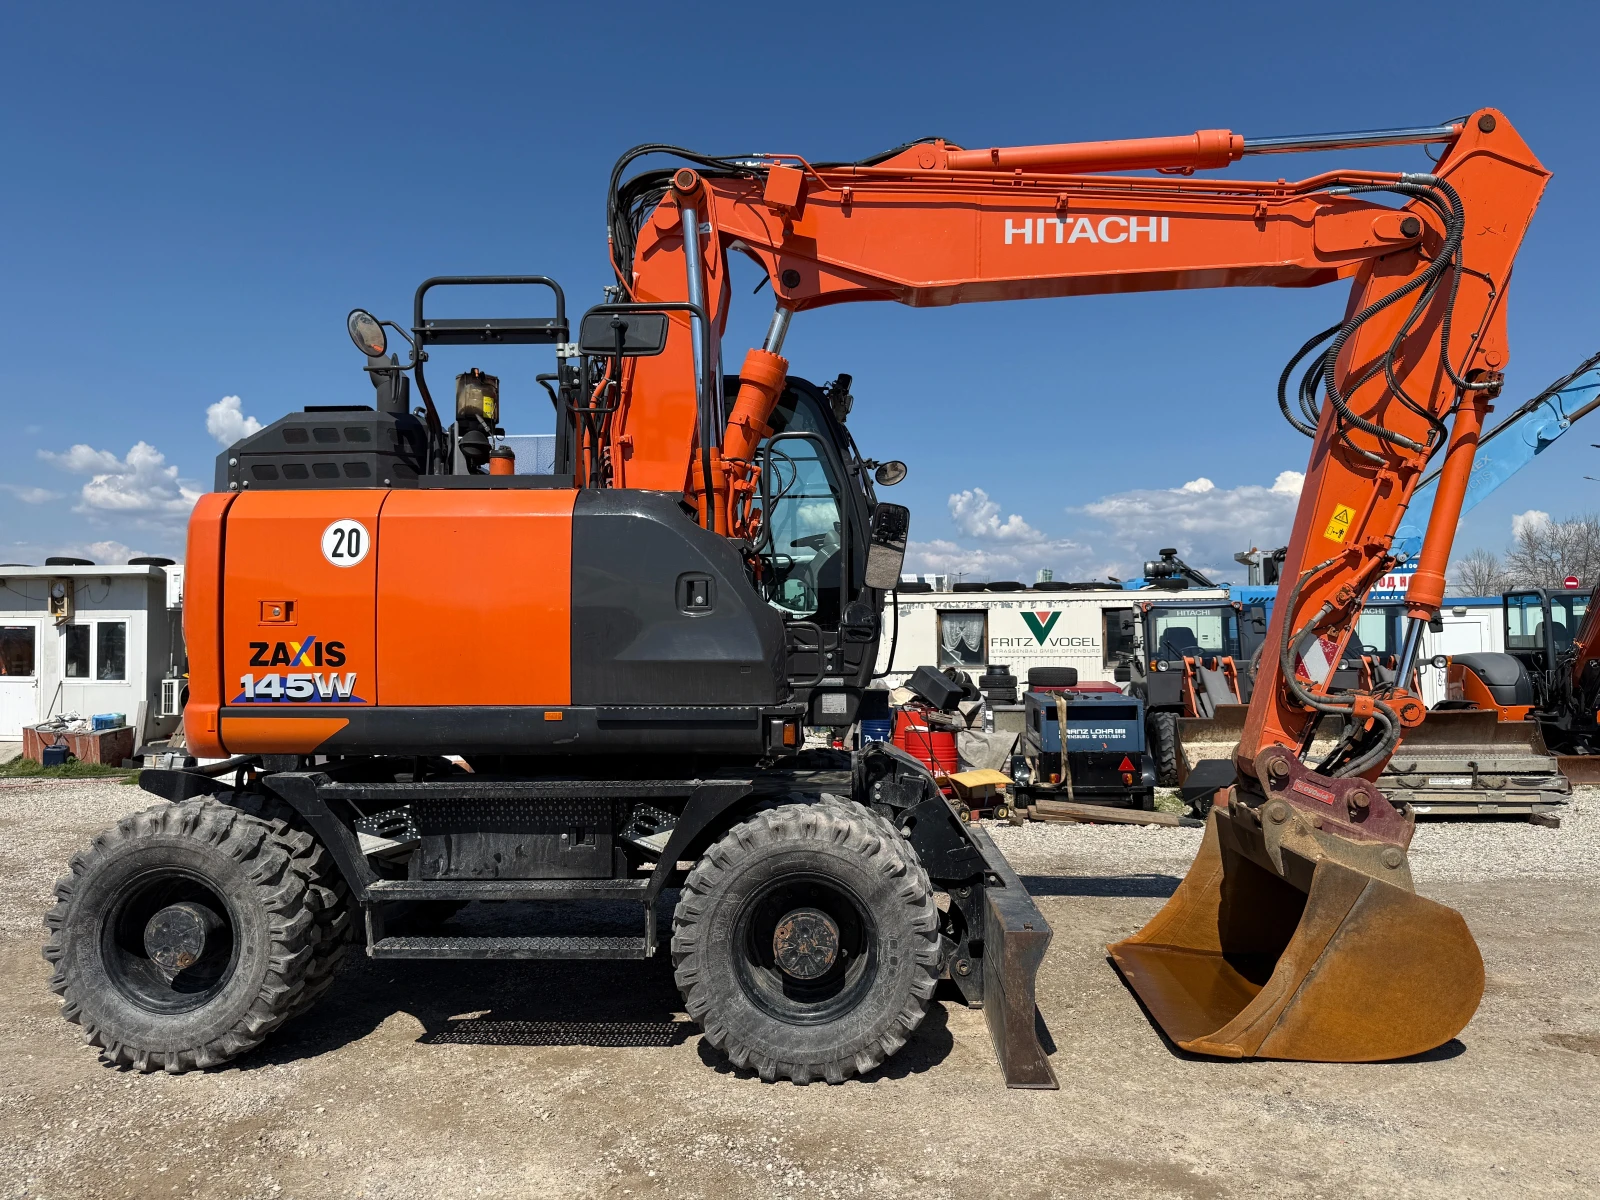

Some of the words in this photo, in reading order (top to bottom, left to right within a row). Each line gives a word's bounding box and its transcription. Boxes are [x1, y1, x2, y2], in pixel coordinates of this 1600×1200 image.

[1004, 216, 1169, 245] HITACHI
[331, 528, 361, 558] 20
[1379, 576, 1396, 589] ОД
[249, 636, 346, 667] ZAXIS
[991, 637, 1034, 647] FRITZ
[1049, 637, 1100, 647] VOGEL
[240, 672, 357, 702] 145W
[930, 768, 951, 779] gies
